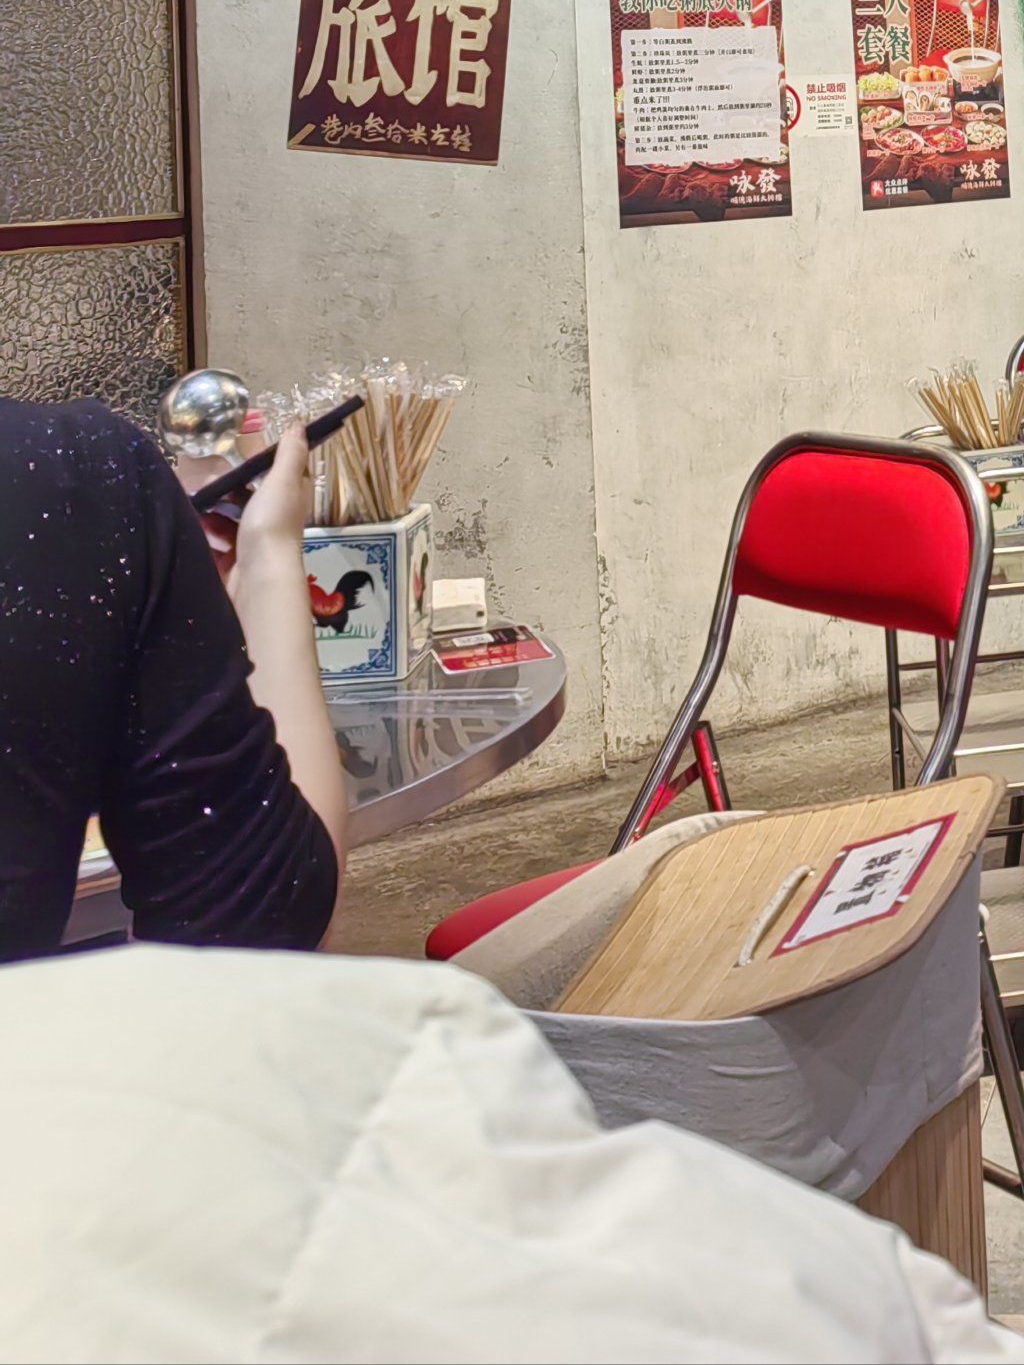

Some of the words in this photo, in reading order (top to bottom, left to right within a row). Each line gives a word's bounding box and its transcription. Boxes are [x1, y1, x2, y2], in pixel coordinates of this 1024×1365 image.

[857, 24, 912, 65] 套餐
[806, 82, 846, 94] 禁止吸烟
